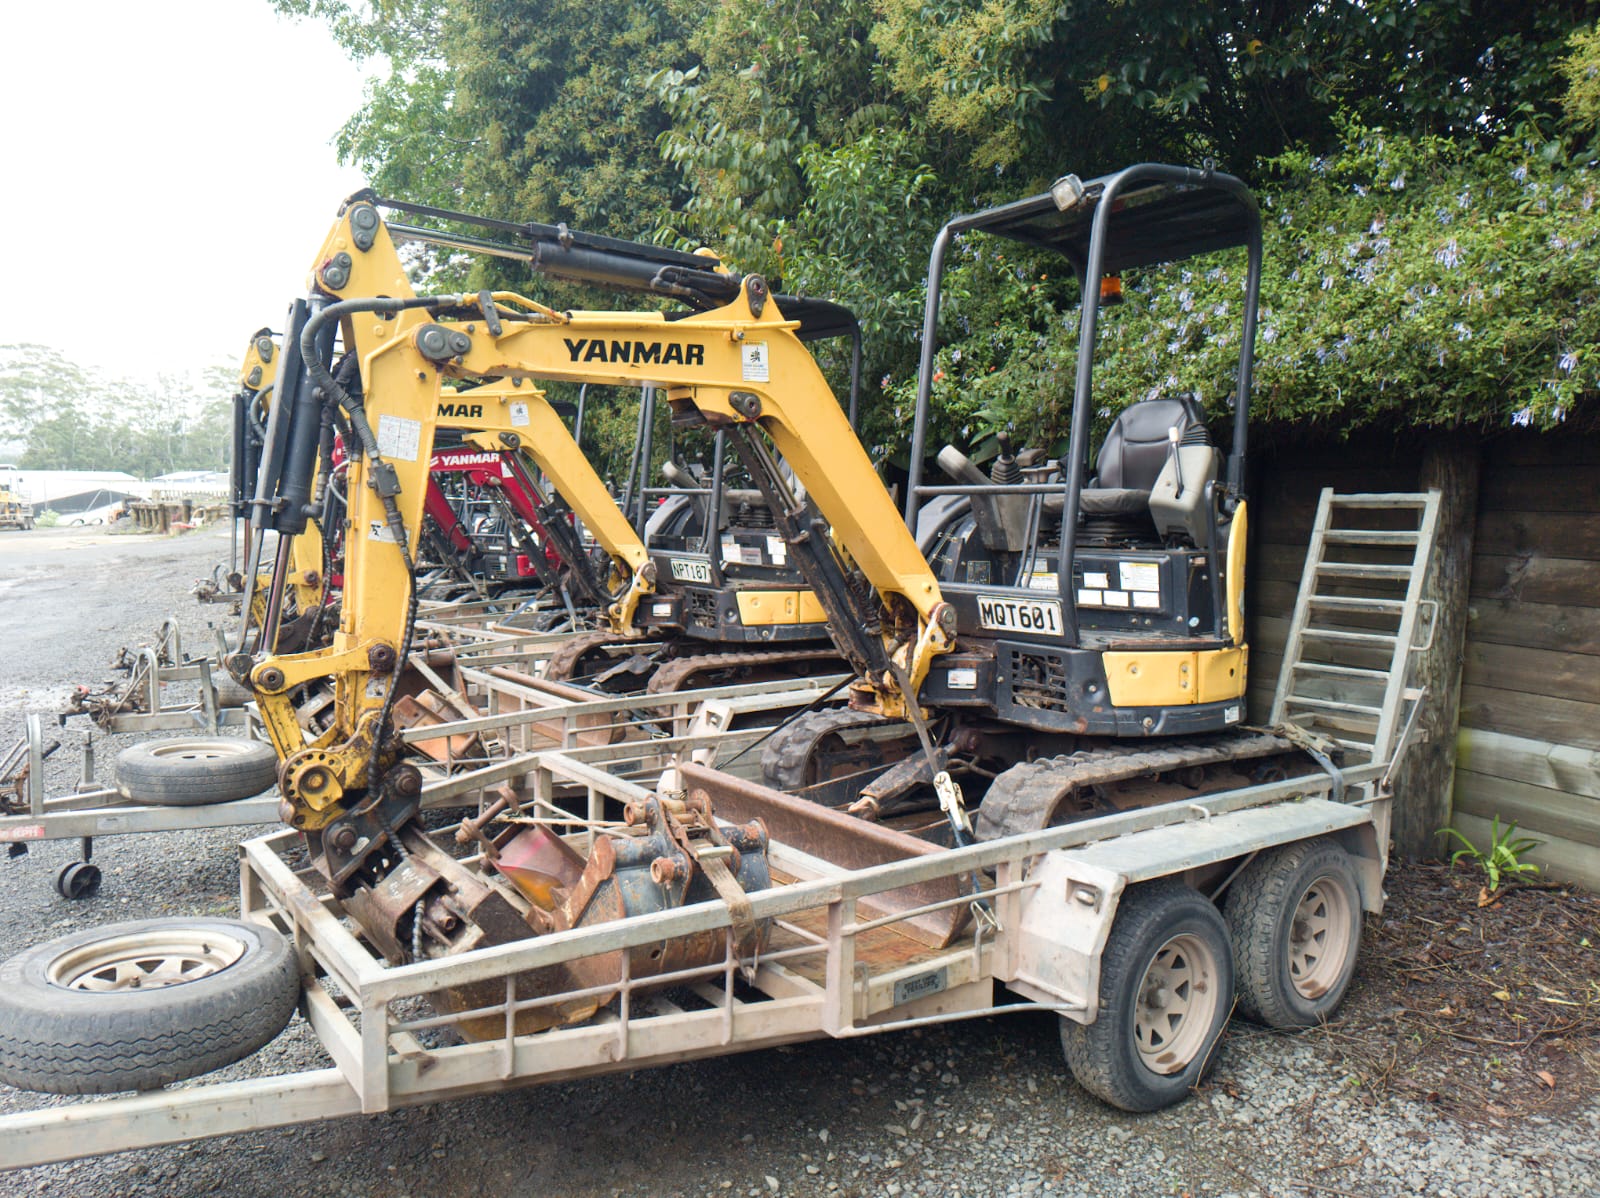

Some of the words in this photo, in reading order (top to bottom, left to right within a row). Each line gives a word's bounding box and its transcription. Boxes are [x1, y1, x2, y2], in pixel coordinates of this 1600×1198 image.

[563, 338, 705, 366] YANMAR
[437, 403, 483, 418] MAR
[440, 452, 501, 467] YANMAR
[672, 562, 707, 580] NPT187
[981, 602, 1055, 630] MQT601
